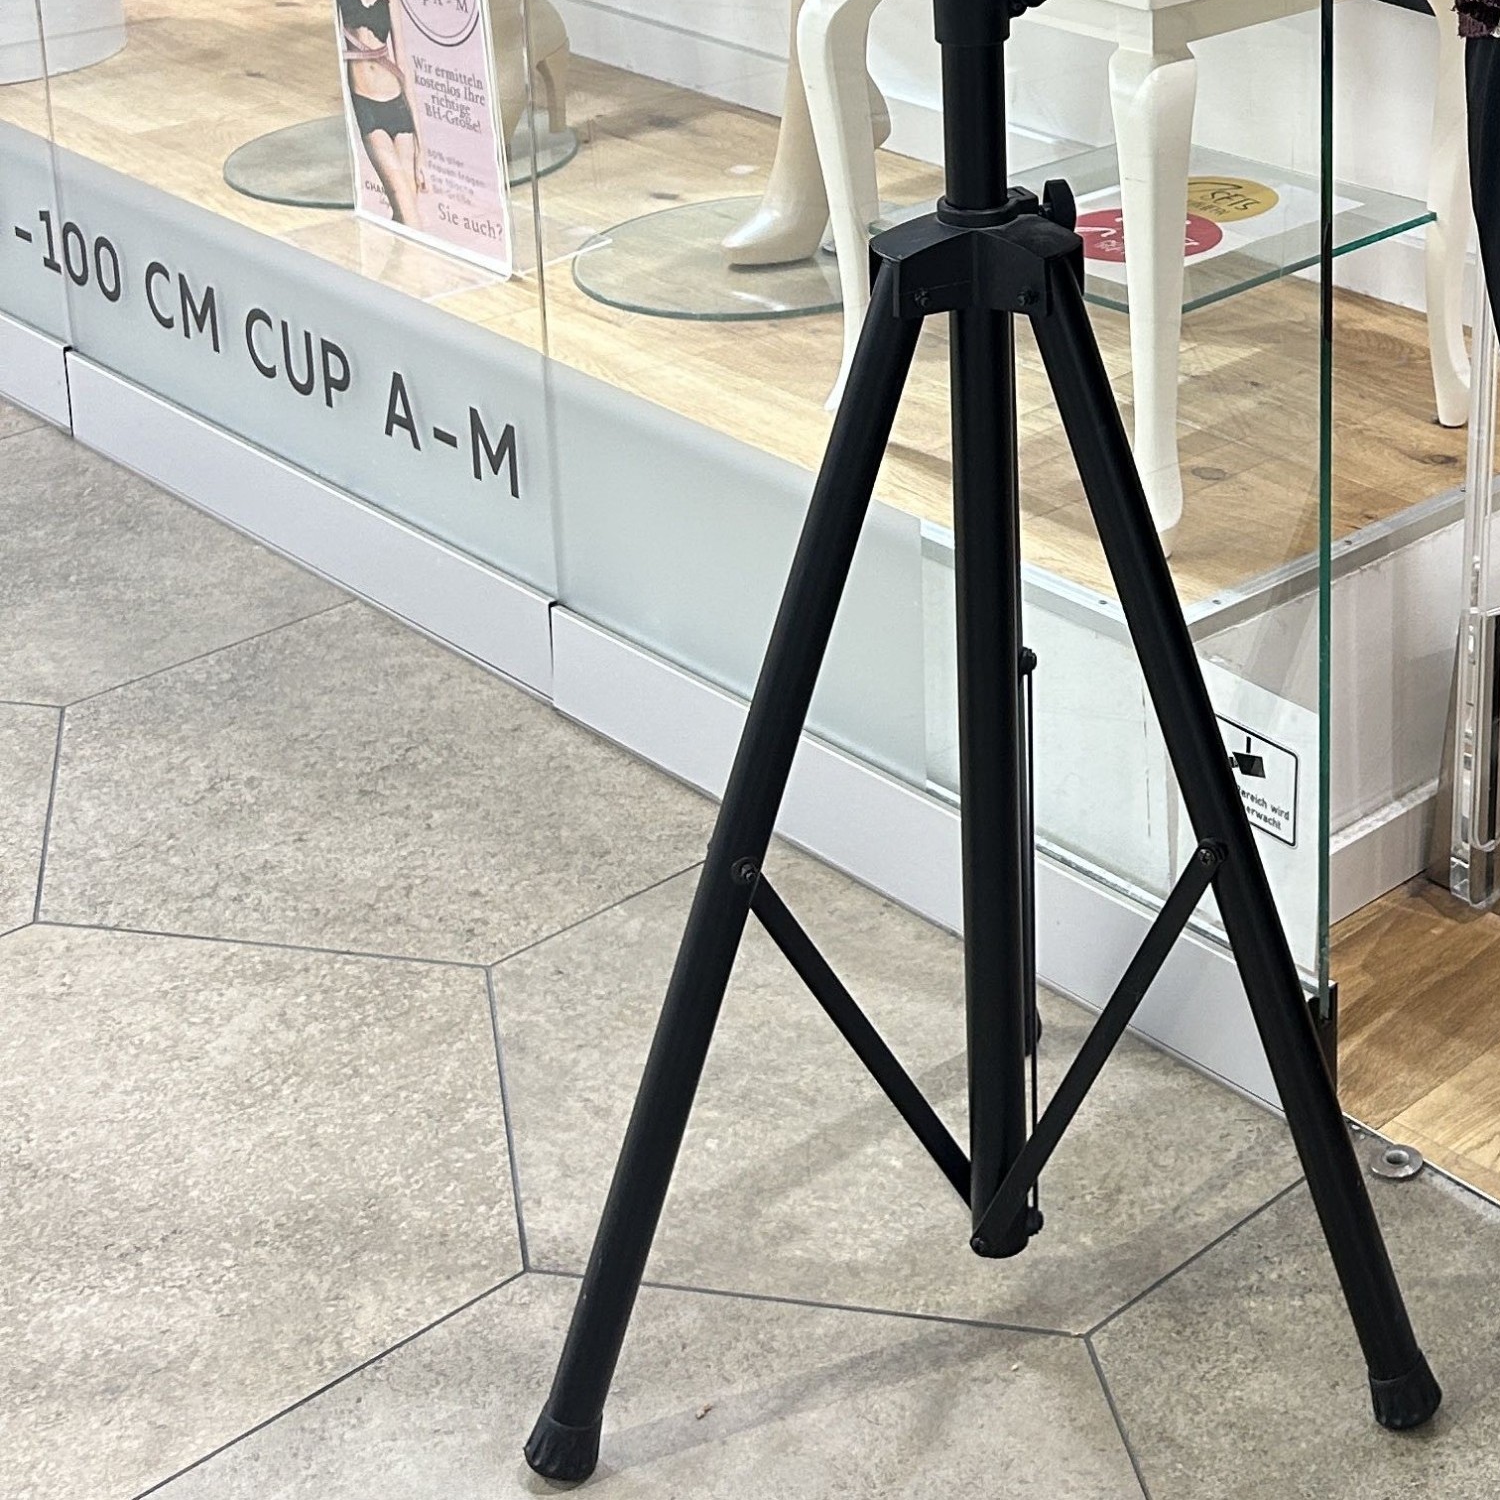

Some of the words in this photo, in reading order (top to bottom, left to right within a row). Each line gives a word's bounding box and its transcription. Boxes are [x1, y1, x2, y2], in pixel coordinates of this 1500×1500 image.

[412, 55, 432, 74] Wir
[435, 67, 483, 90] ermitteln
[414, 70, 460, 98] kostenlos
[464, 87, 485, 106] Ihre
[431, 92, 471, 118] richtige
[438, 203, 460, 225] Sie
[464, 217, 503, 241] auch?
[145, 261, 220, 354] CM
[245, 307, 351, 408] CUP
[1246, 805, 1282, 831] erwacht
[1270, 803, 1290, 821] wird
